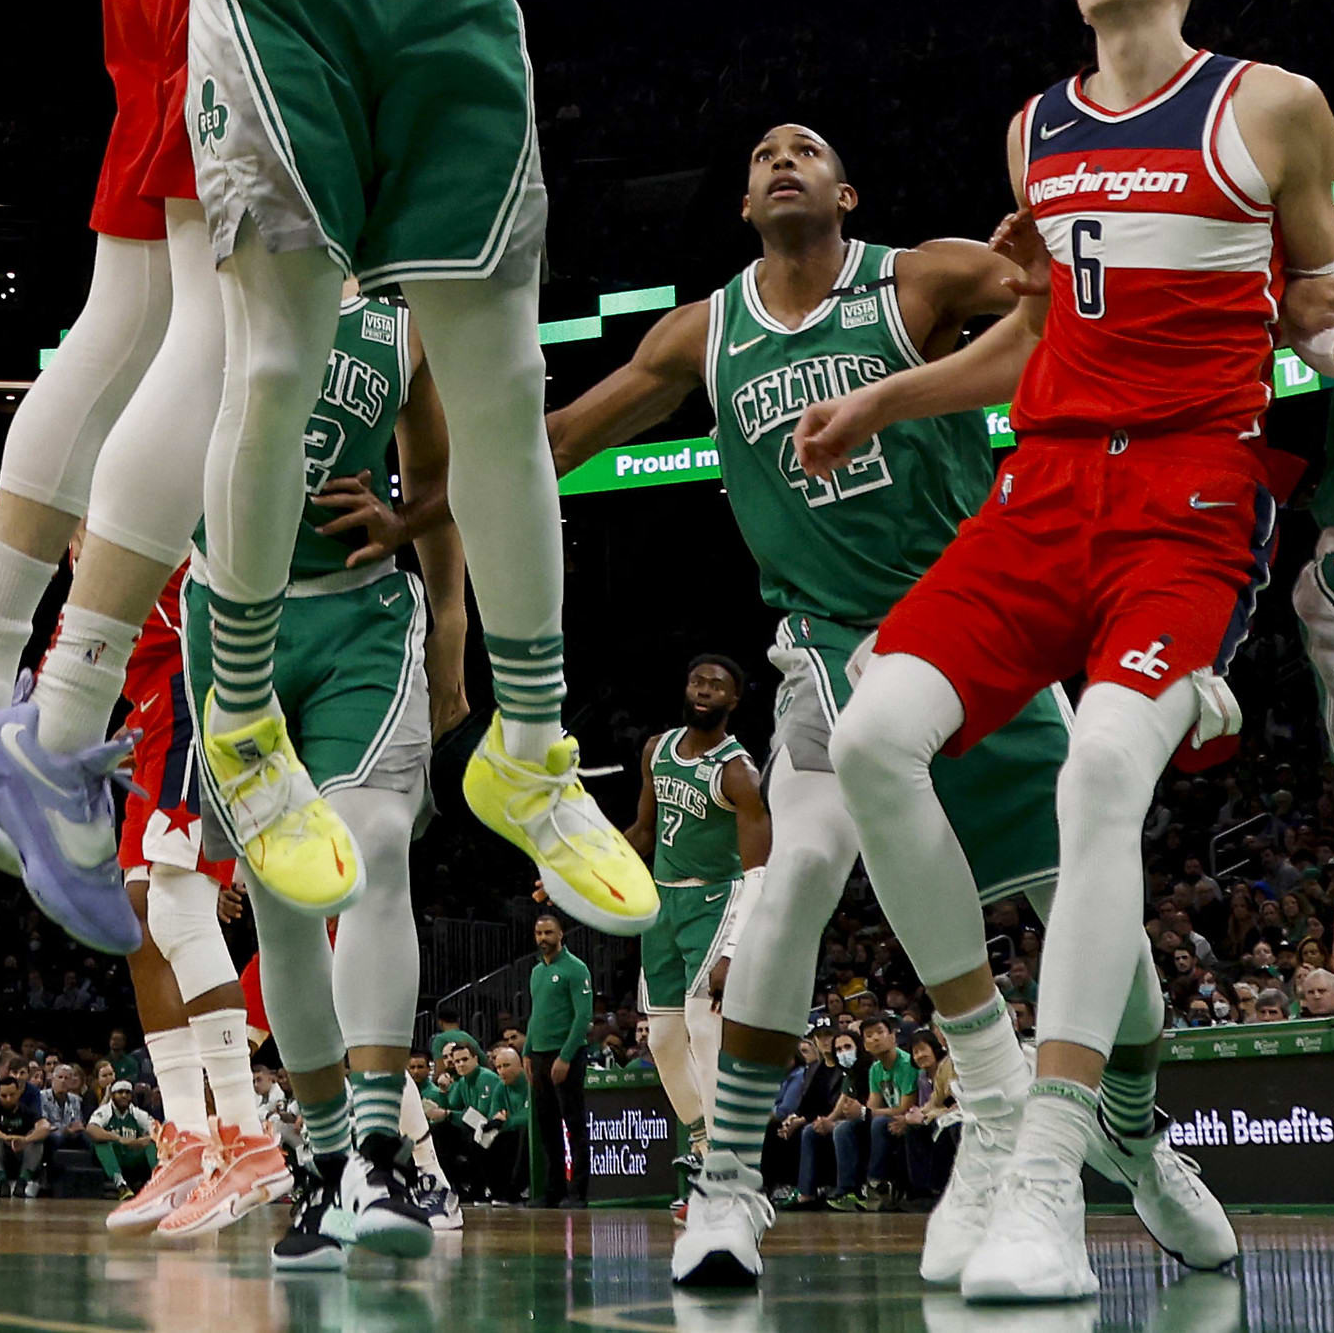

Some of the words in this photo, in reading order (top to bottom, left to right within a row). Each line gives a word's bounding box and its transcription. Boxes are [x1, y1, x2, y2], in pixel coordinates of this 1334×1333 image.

[1028, 161, 1188, 206] washington
[1070, 218, 1105, 319] 6
[367, 315, 391, 332] VISTA
[845, 301, 874, 316] VISTA
[1281, 356, 1316, 389] TD
[731, 354, 887, 446] CELTICS
[616, 450, 691, 477] Proud
[1119, 641, 1171, 681] dc
[654, 776, 707, 820] ELTICS
[662, 806, 683, 847] 7
[628, 1110, 667, 1149] Pilgrim
[1166, 1109, 1227, 1146] ealth
[1231, 1106, 1332, 1144] Benefits
[621, 1144, 646, 1175] Care
